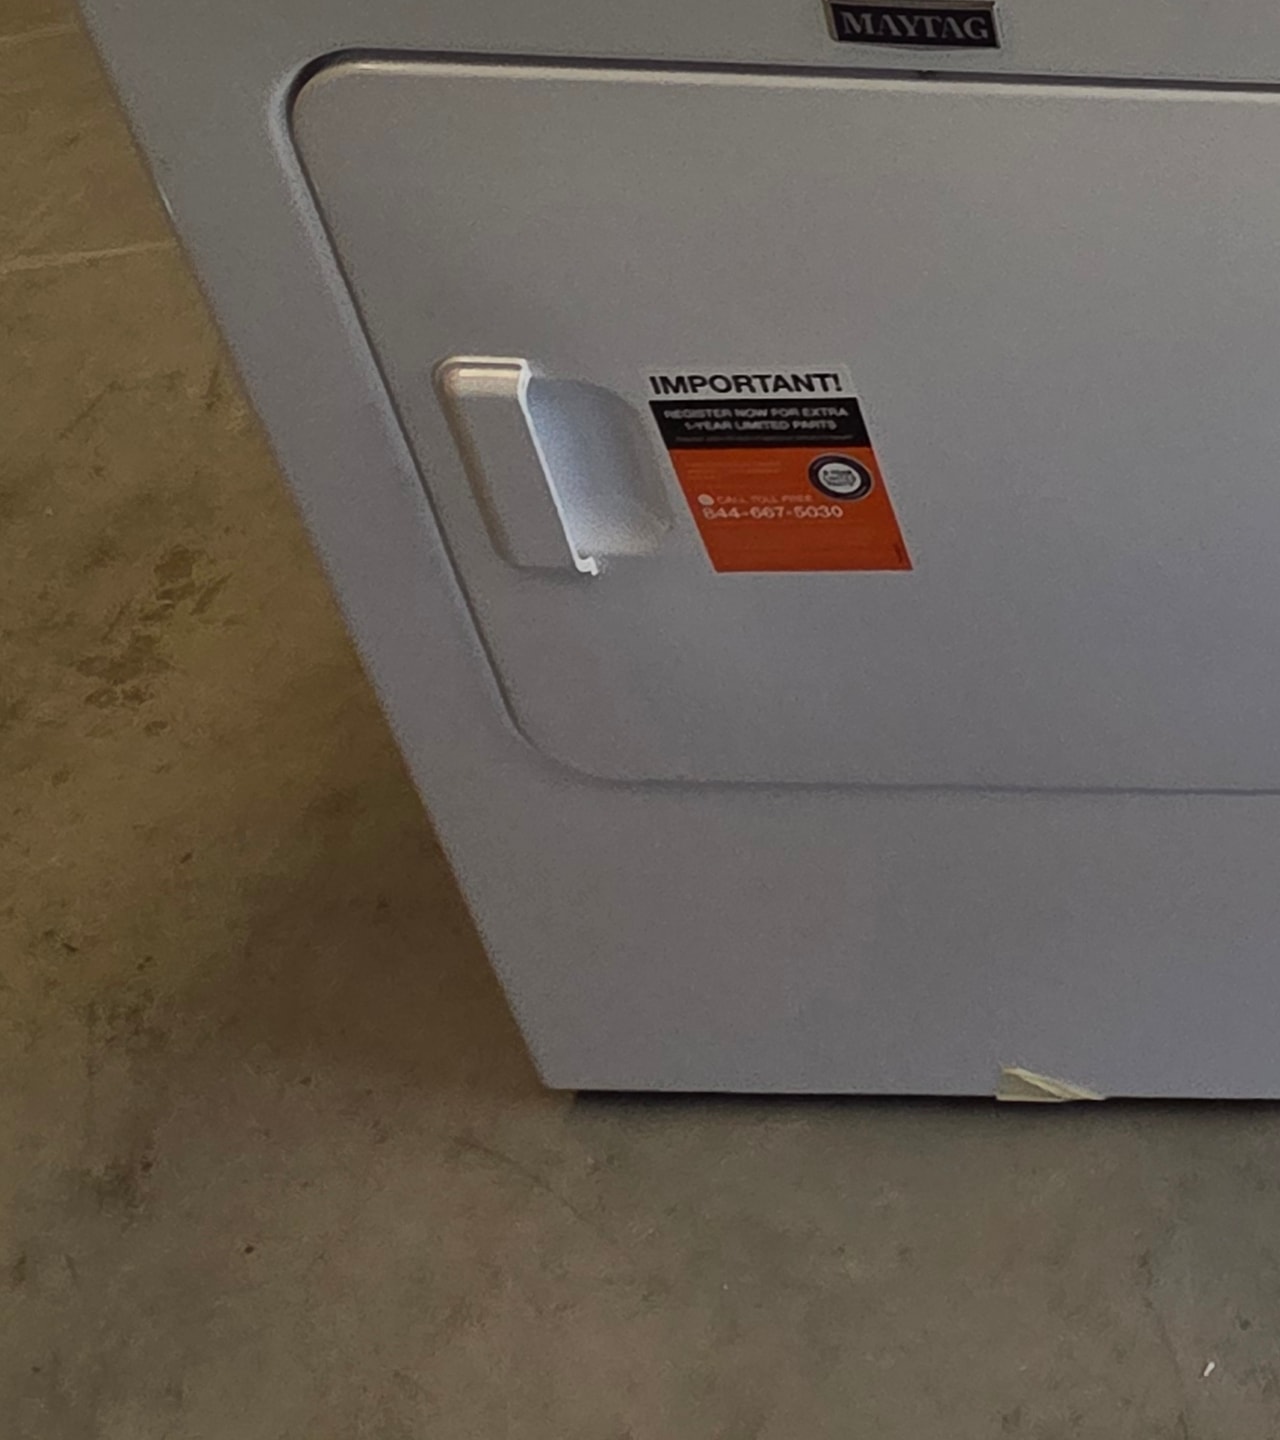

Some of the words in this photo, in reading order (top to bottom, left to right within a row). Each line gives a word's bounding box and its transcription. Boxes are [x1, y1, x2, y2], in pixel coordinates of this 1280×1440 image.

[840, 10, 989, 40] MAYTAG
[649, 373, 843, 395] IMPORTANT!
[664, 408, 733, 420] REGISTER
[735, 407, 769, 419] NOW
[770, 407, 800, 418] FOR
[802, 406, 849, 418] EXTRA
[735, 420, 789, 432] LIMITED
[793, 419, 837, 431] PARTS
